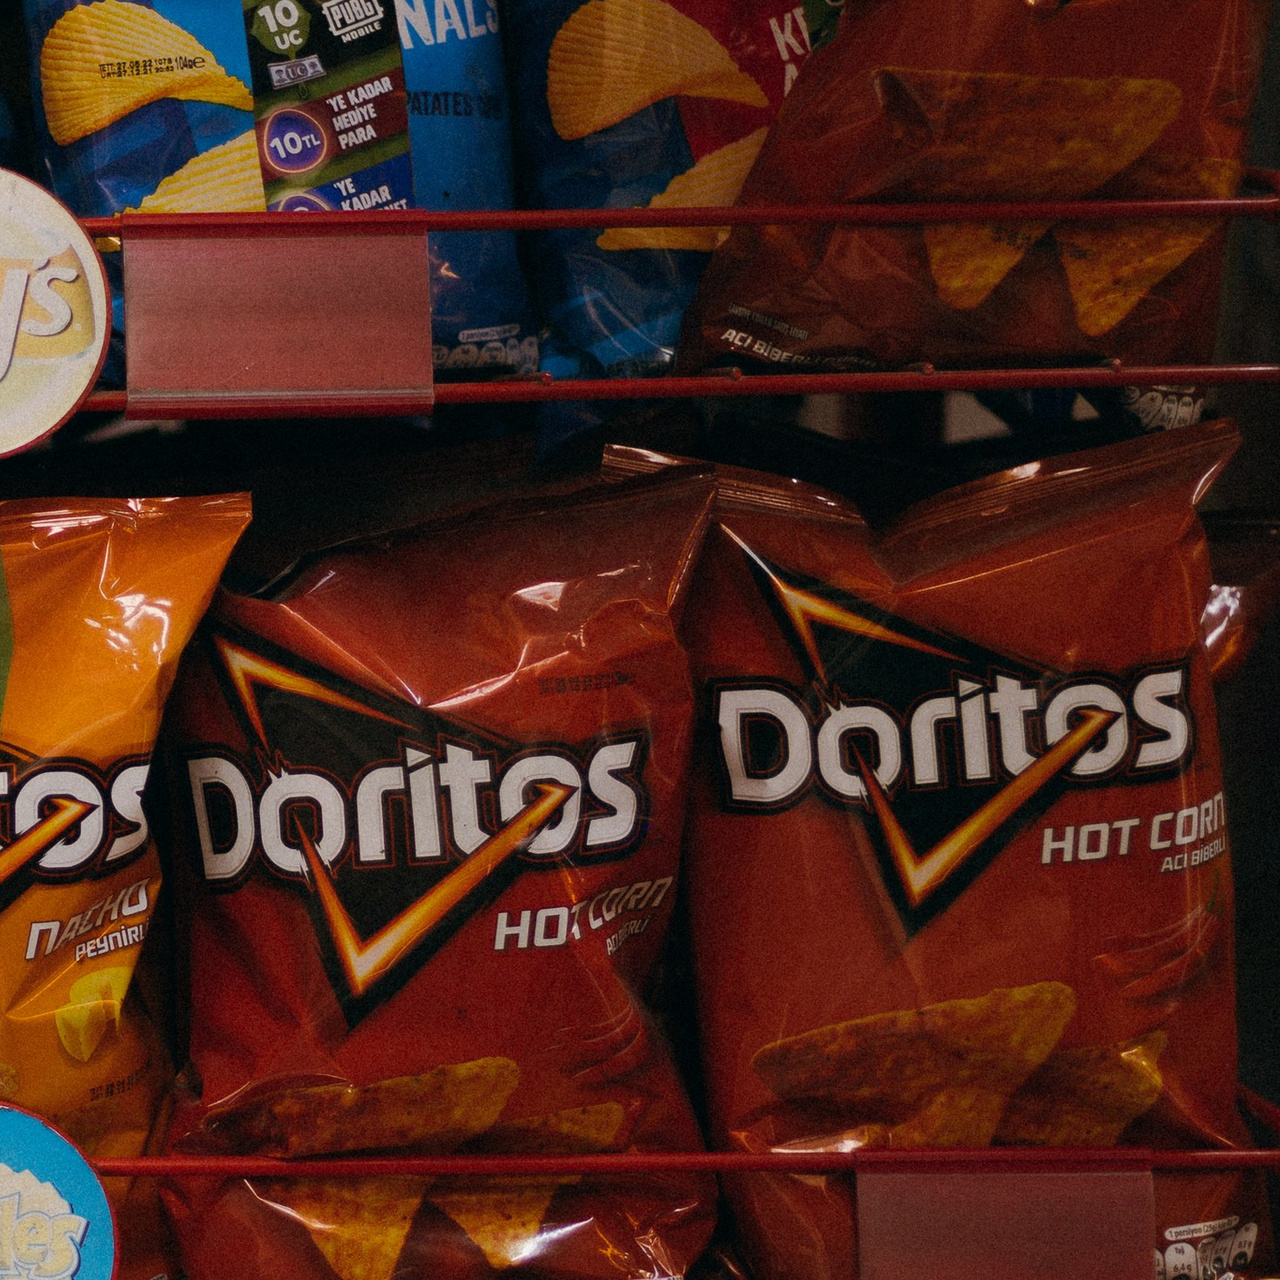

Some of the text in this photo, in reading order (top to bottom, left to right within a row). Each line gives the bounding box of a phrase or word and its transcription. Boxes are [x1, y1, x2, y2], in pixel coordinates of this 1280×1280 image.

[273, 29, 304, 51] UC
[340, 20, 383, 44] MOBILE
[347, 75, 394, 107] KADAR
[332, 102, 378, 132] HEDİYE
[337, 124, 378, 150] PARA
[718, 668, 1190, 802] Doritos
[186, 741, 638, 881] Doritos
[1040, 792, 1226, 865] HOT CORN
[1159, 851, 1190, 874] ACI
[493, 902, 582, 952] HOT
[587, 874, 675, 931] CORN
